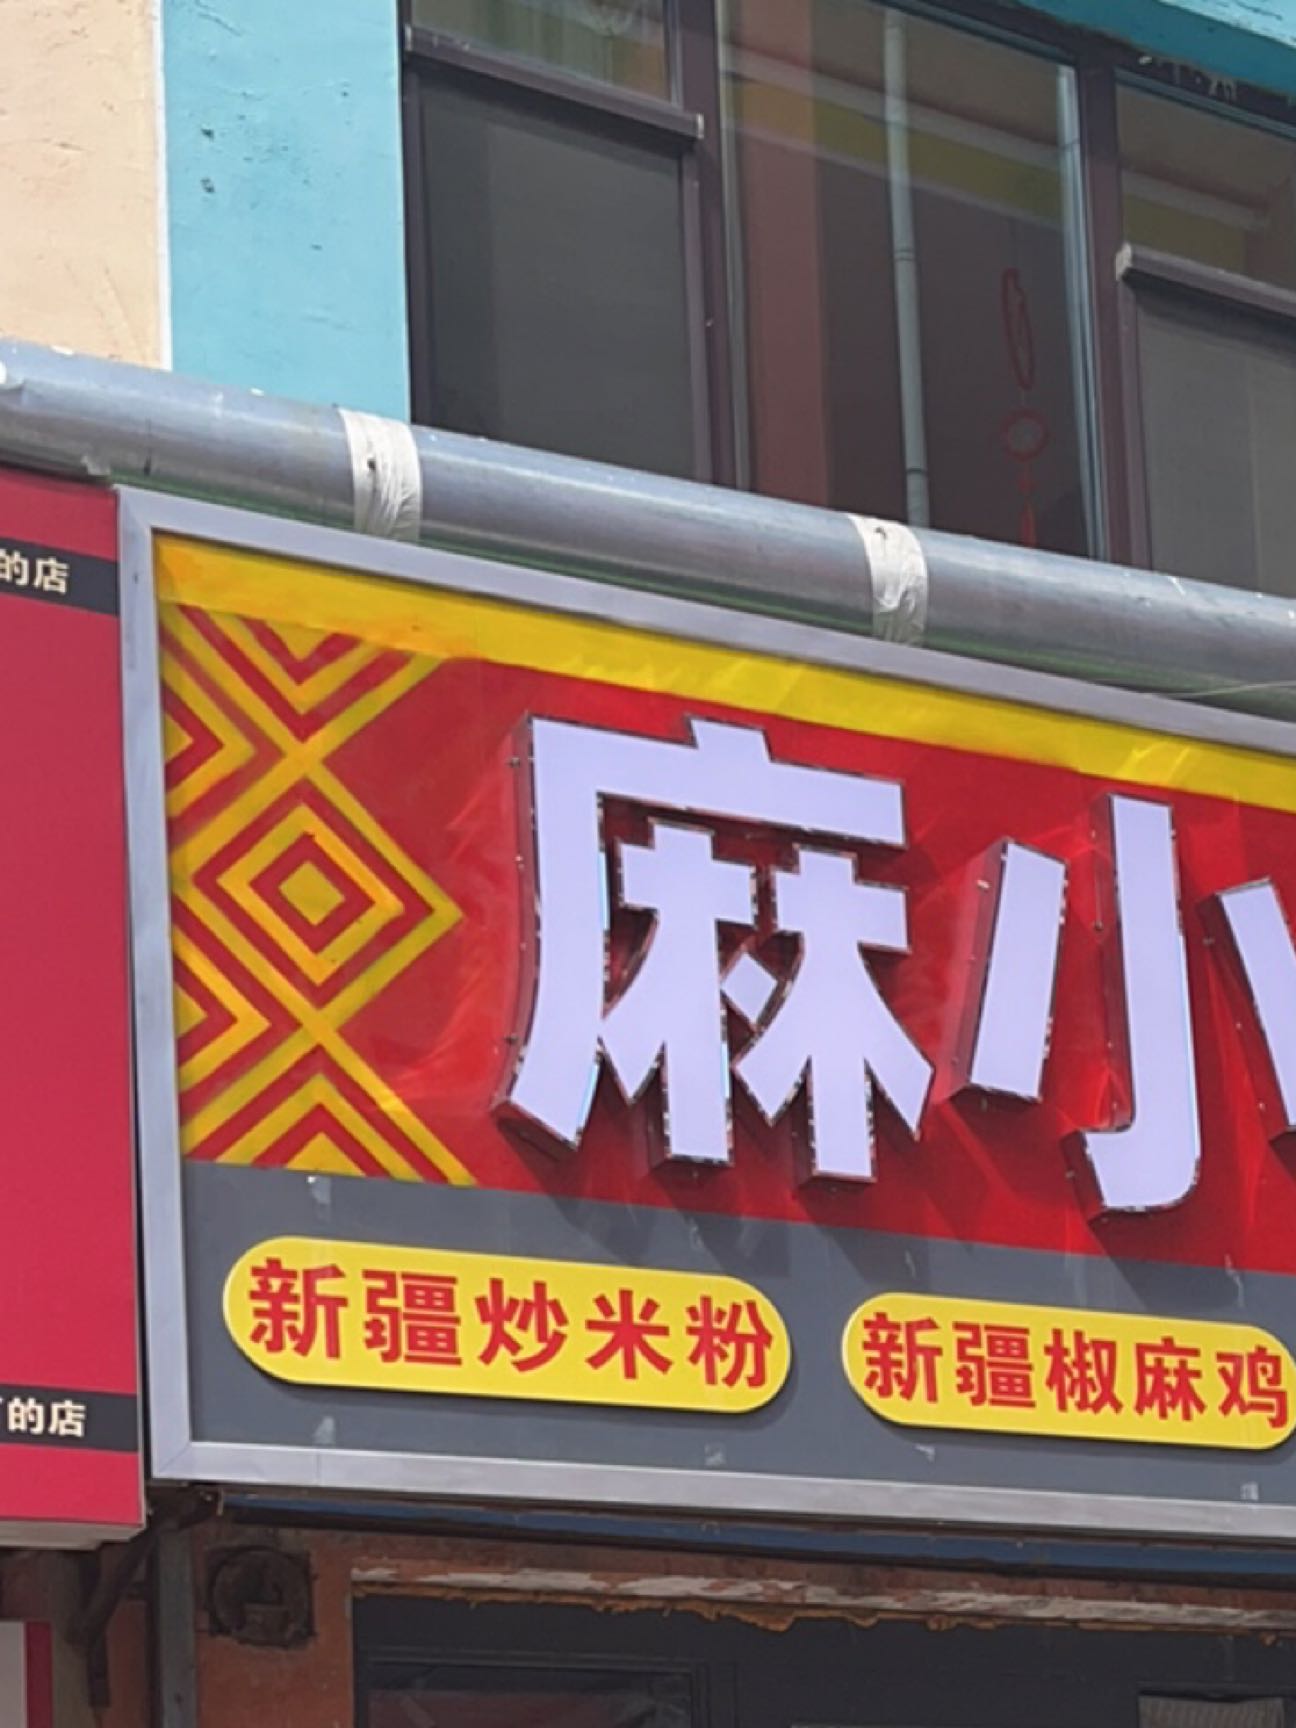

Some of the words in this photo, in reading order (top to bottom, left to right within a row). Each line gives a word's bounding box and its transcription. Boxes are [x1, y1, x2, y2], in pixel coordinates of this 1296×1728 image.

[0, 548, 69, 595] 的店
[248, 1257, 773, 1389] 新疆炒米粉
[862, 1310, 1289, 1430] 新疆椒麻鸡
[0, 1396, 86, 1438] 的店
